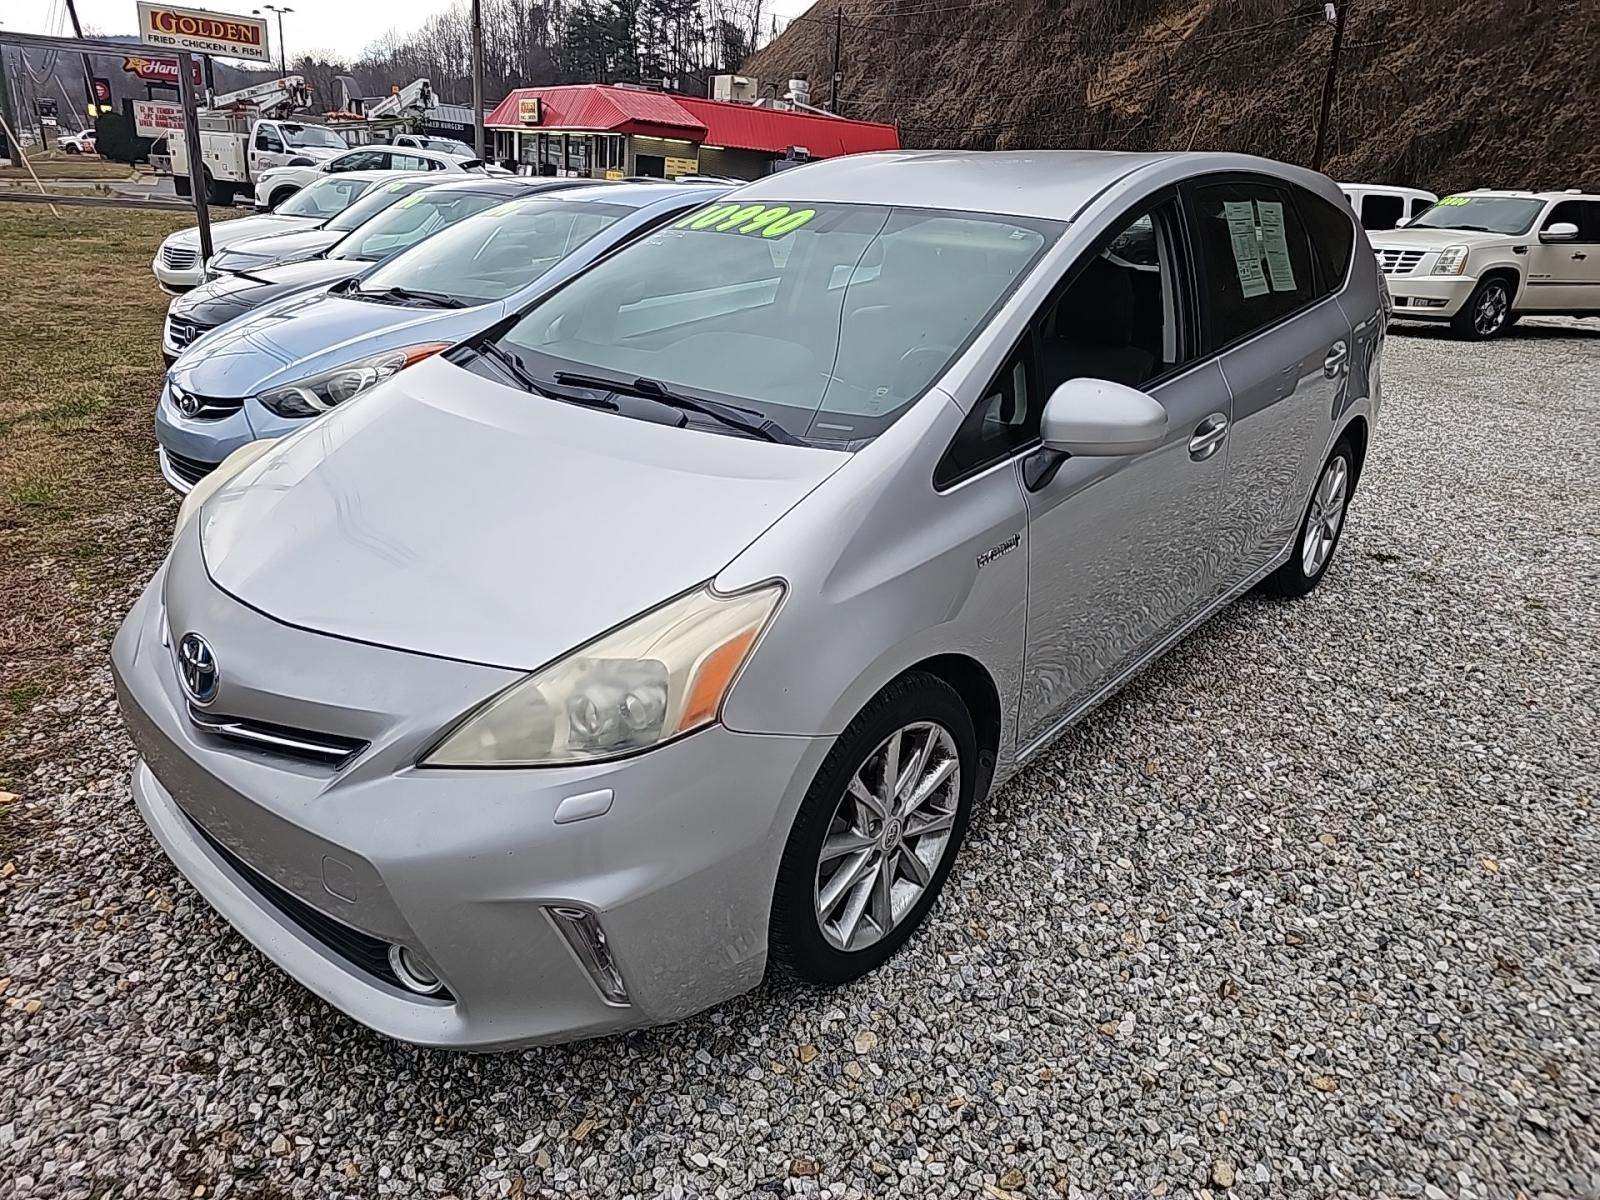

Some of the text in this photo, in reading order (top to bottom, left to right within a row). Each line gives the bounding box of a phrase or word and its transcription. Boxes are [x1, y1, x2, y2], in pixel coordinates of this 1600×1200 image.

[155, 10, 254, 42] GOLDEN
[148, 34, 176, 45] FRIED
[182, 39, 227, 52] CHICKEN
[242, 48, 262, 57] FISH
